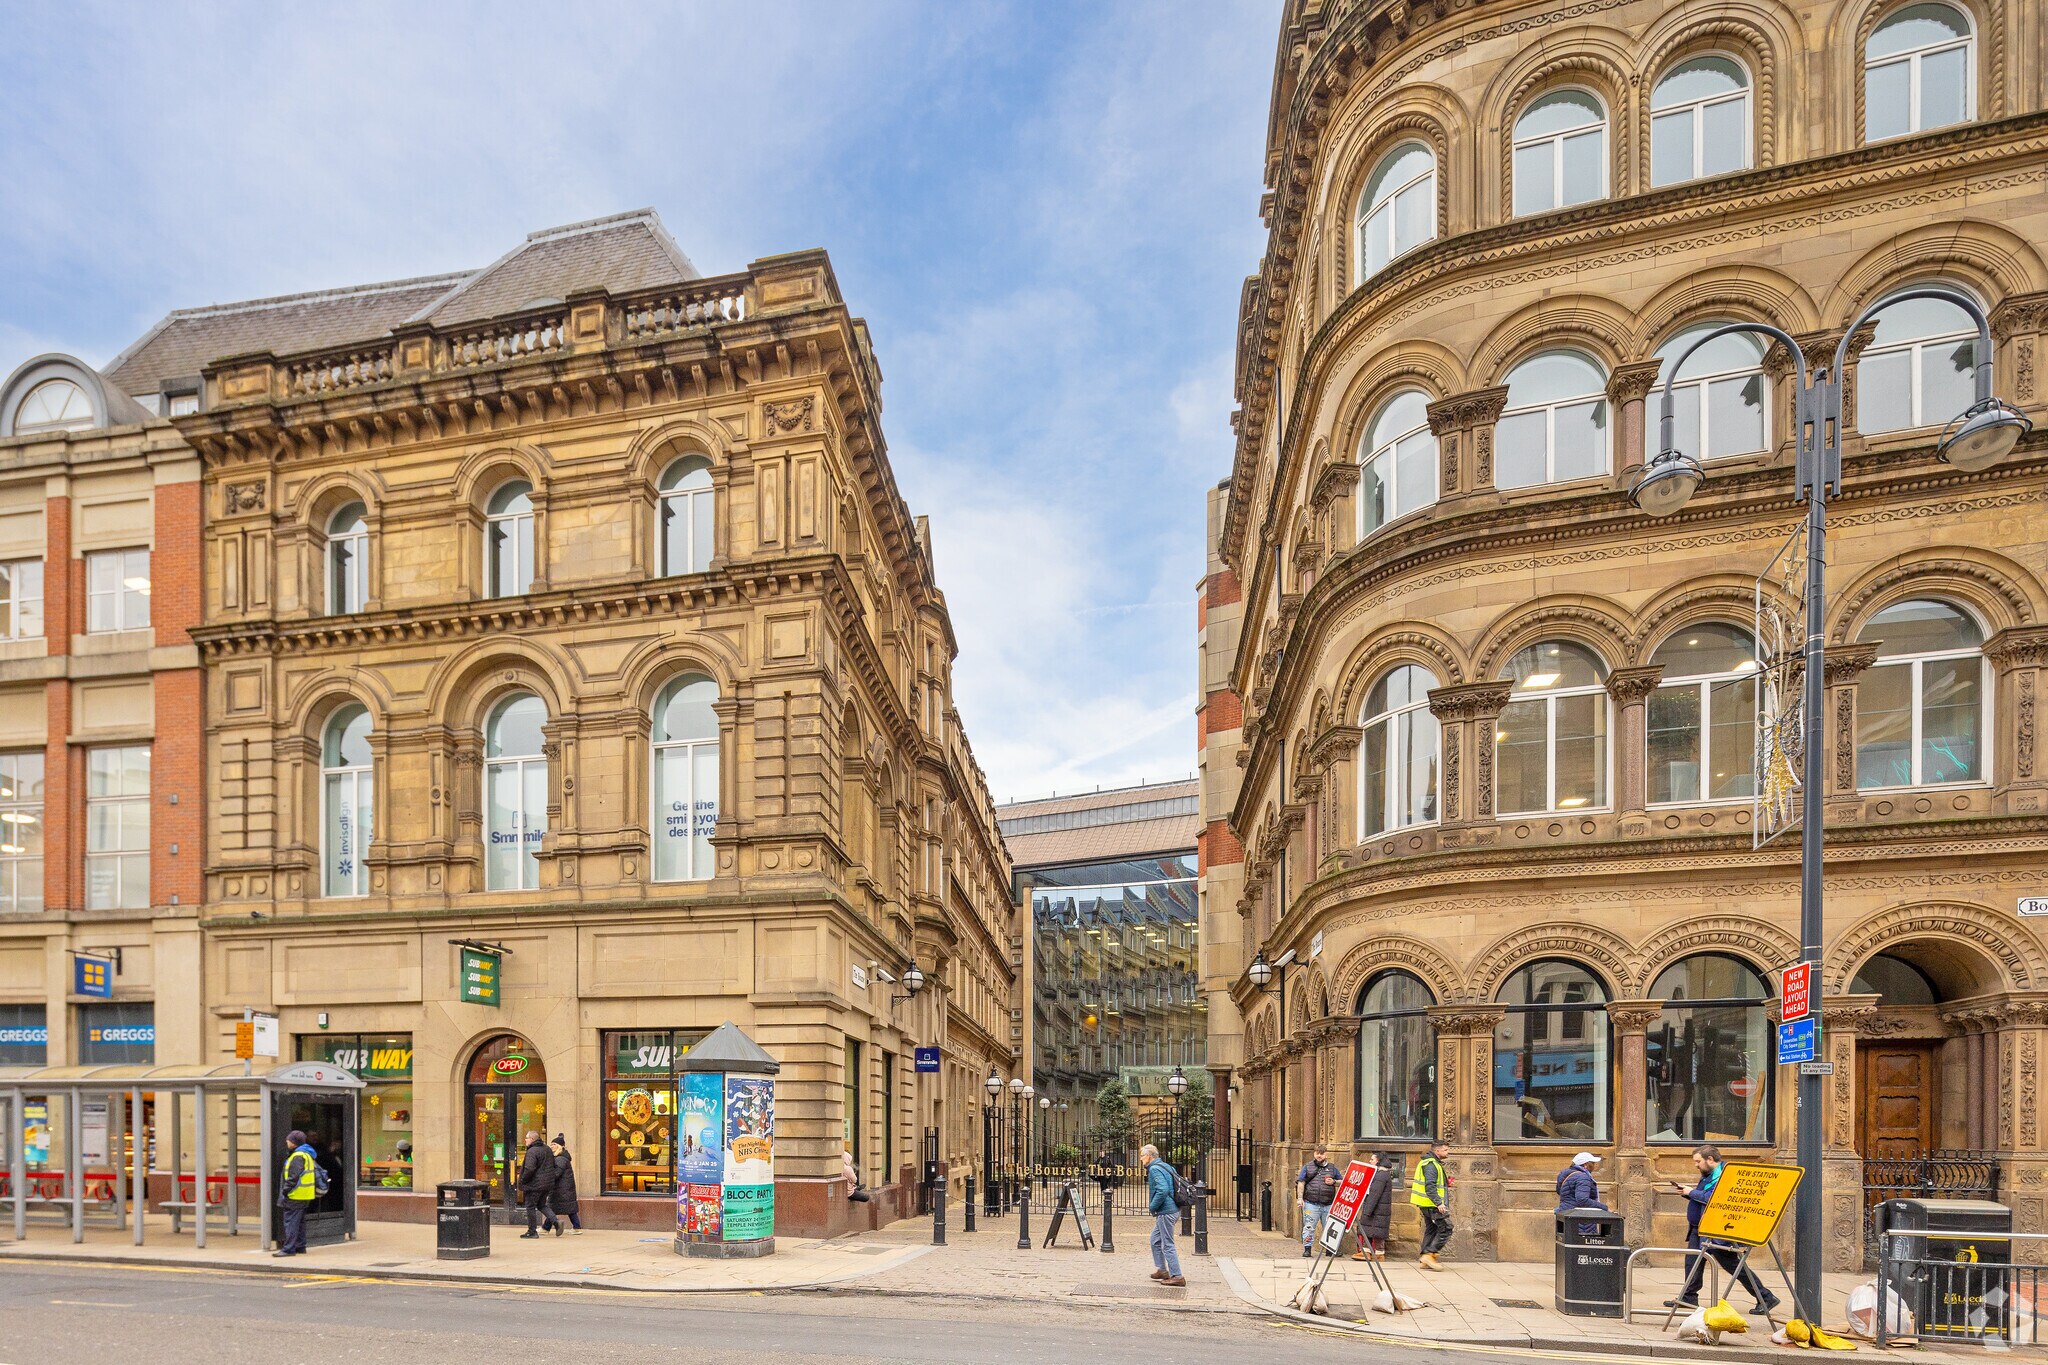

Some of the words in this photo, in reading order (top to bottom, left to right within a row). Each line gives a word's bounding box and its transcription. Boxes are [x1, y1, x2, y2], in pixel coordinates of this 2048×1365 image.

[666, 813, 697, 825] smie
[339, 801, 351, 855] invisalign
[2028, 901, 2048, 911] Bo
[468, 959, 493, 970] SUBWAY
[468, 973, 493, 984] SUBWAY
[1789, 969, 1804, 981] NEW
[468, 986, 494, 997] SUBWAY
[1787, 980, 1804, 992] ROAD
[1784, 990, 1807, 1004] LAYOUT
[1785, 1002, 1806, 1015] AHEAD
[0, 1029, 47, 1042] GREGGS
[103, 1028, 154, 1041] GREGGS
[631, 1045, 690, 1068] SUB
[498, 1059, 523, 1071] OPEN
[738, 1148, 753, 1157] NHS
[1008, 1163, 1031, 1177] The
[1035, 1163, 1080, 1176] Bourse
[1089, 1164, 1115, 1177] The
[1737, 1169, 1750, 1177] NEW
[1752, 1170, 1779, 1180] STATION
[1348, 1170, 1365, 1186] ROAD
[1737, 1178, 1745, 1186] ST
[1745, 1179, 1770, 1188] CLOSED
[727, 1190, 753, 1200] BLOC
[1340, 1186, 1359, 1203] AHEAD
[1729, 1187, 1753, 1196] ACCESS
[1754, 1189, 1766, 1197] FOR
[1727, 1195, 1761, 1205] DELIVERIES
[1332, 1202, 1353, 1221] CLOSED
[1709, 1203, 1743, 1212] AUTHORISED
[1743, 1206, 1777, 1218] VEHICLES
[1727, 1213, 1741, 1221] ONLY
[1589, 1256, 1613, 1264] Leeds
